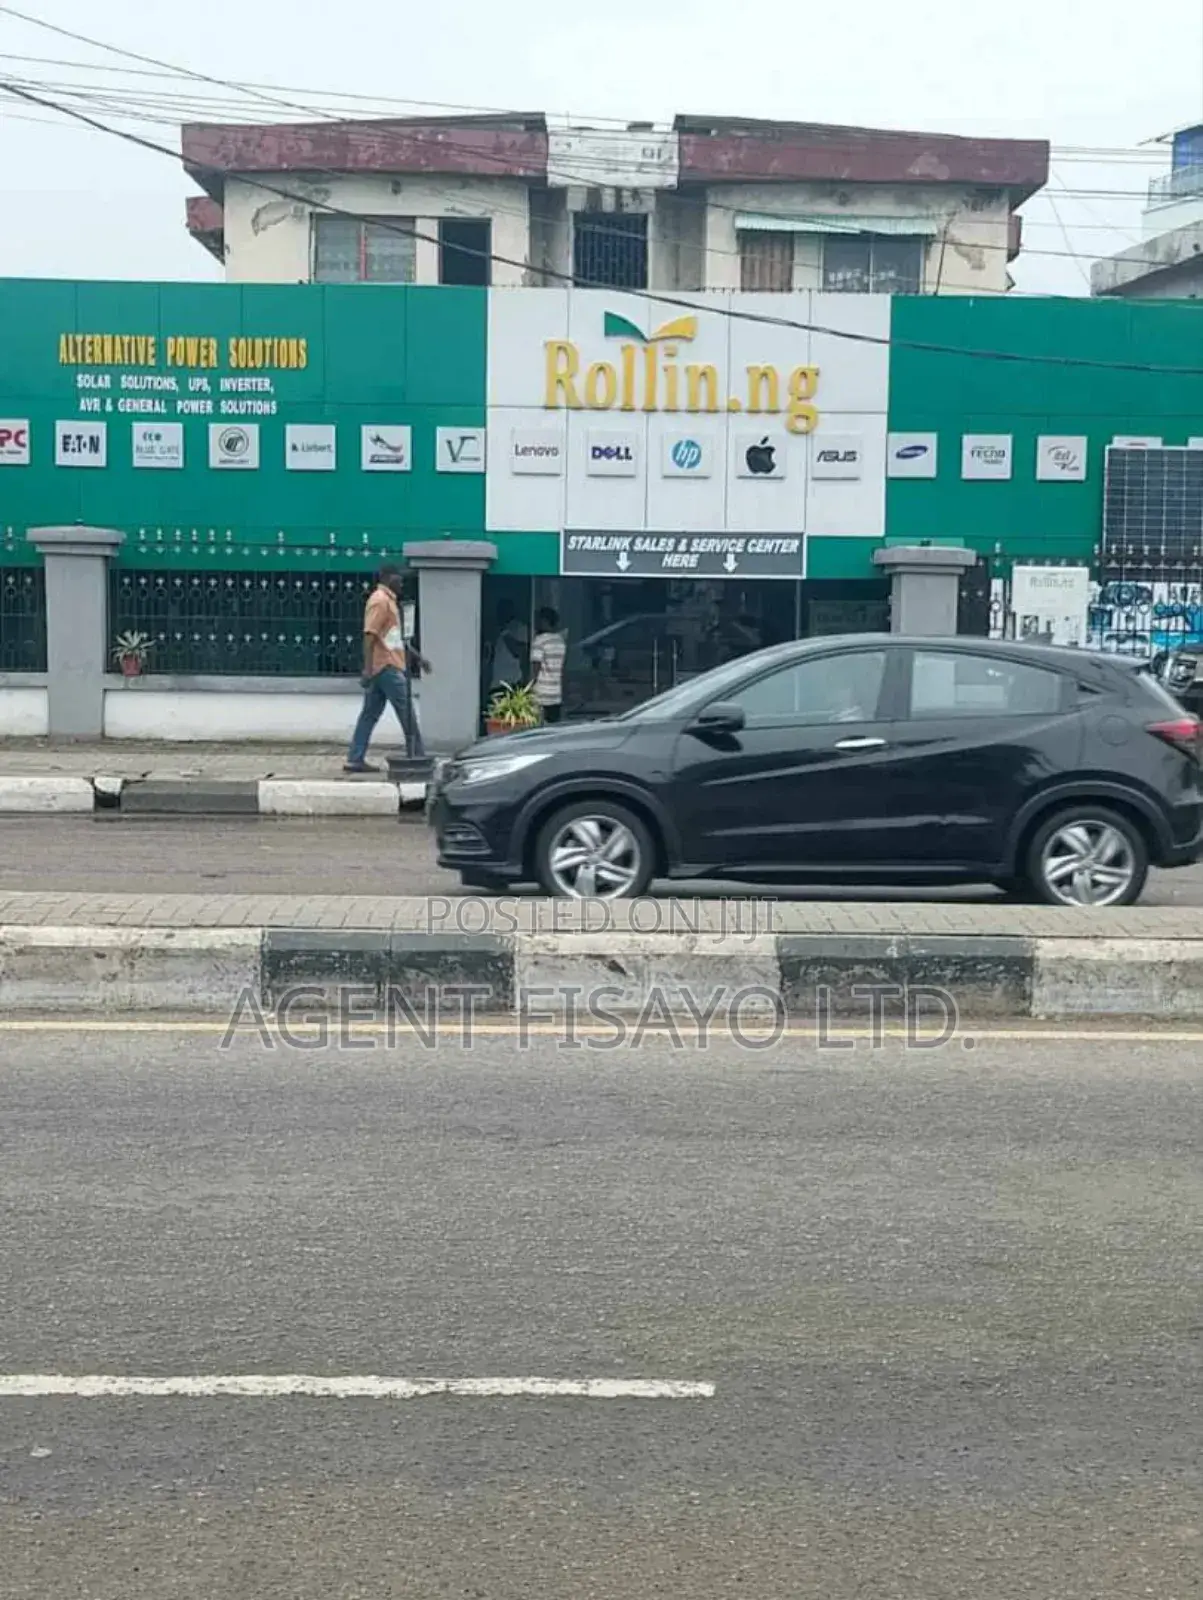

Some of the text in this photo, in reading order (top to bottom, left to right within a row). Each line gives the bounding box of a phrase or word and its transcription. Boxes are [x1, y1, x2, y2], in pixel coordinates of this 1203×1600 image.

[59, 334, 308, 369] ALTERNATIVE POWER SOLUTIONS
[76, 374, 275, 395] SOLAR SOLUTIONS, UPS, INVERTER,
[543, 337, 820, 435] Rollin.ng
[80, 397, 278, 416] AVR & GENERAL POWER SOLUTIONS
[514, 443, 559, 457] Lenovo
[591, 446, 633, 461] DELL
[674, 440, 700, 468] hp
[816, 449, 858, 463] ASUS
[567, 535, 800, 554] STARLINK SALES & SERVICE CENTER
[661, 553, 700, 568] HERE
